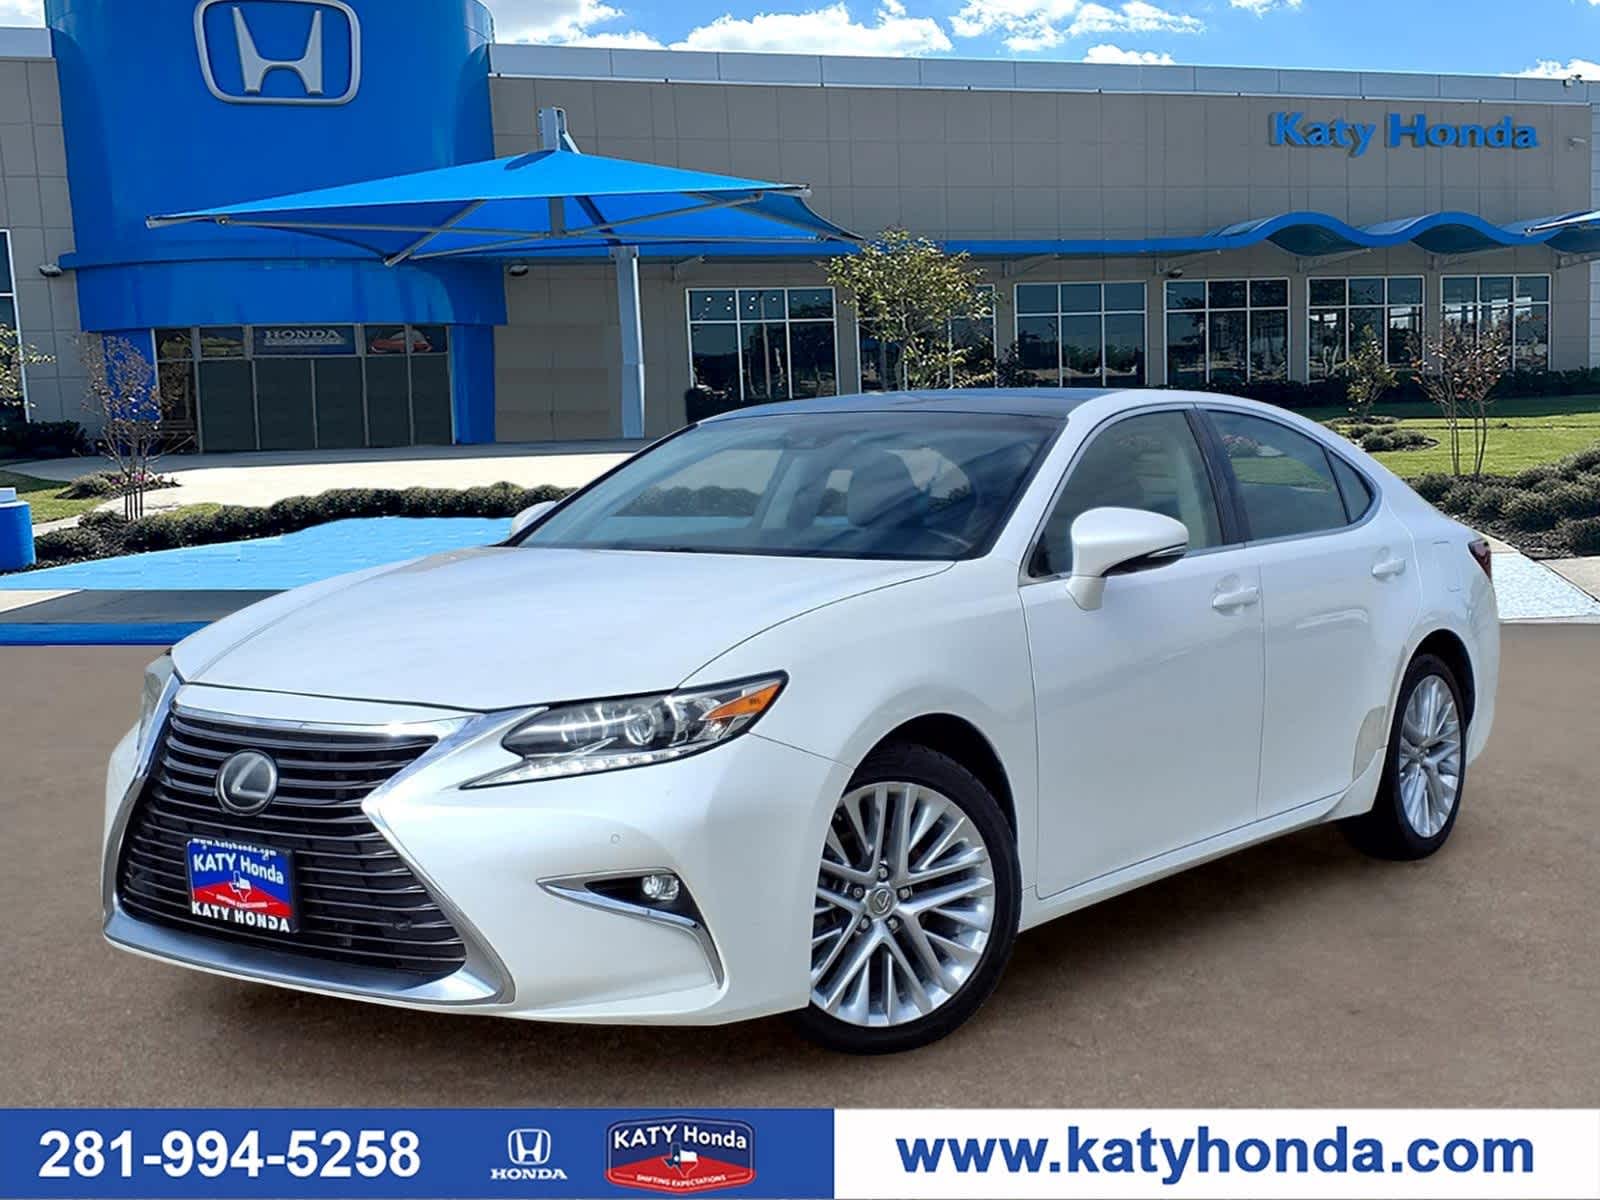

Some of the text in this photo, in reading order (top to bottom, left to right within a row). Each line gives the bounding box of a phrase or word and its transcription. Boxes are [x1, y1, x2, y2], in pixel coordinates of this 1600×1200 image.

[1270, 112, 1539, 157] Katy Honda
[264, 329, 342, 339] HONDA
[194, 853, 284, 885] KATY Honda
[192, 901, 229, 921] KATY
[234, 909, 290, 933] HONDA
